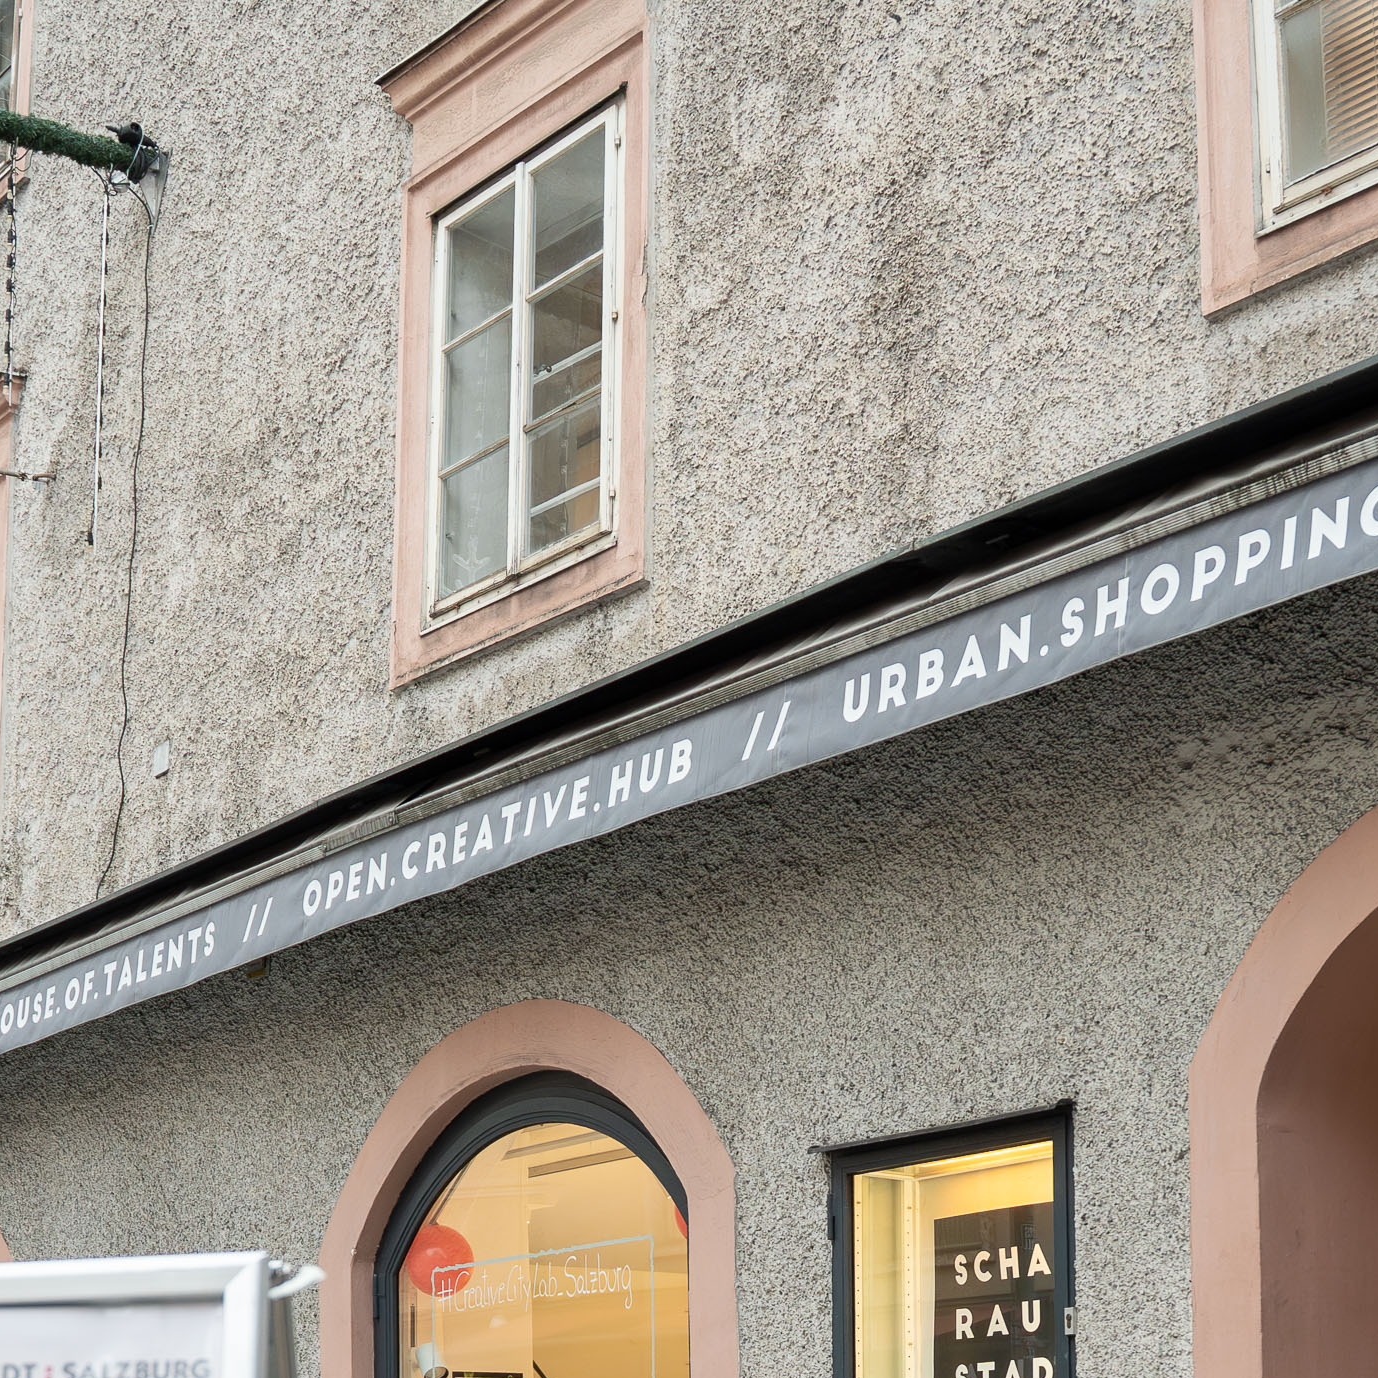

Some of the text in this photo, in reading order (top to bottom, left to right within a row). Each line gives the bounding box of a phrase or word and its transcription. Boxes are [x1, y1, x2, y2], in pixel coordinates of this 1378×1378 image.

[302, 739, 693, 918] OPEN.CREATIVE.HUB
[954, 1243, 1052, 1286] SCHA
[955, 1299, 1041, 1340] RAU
